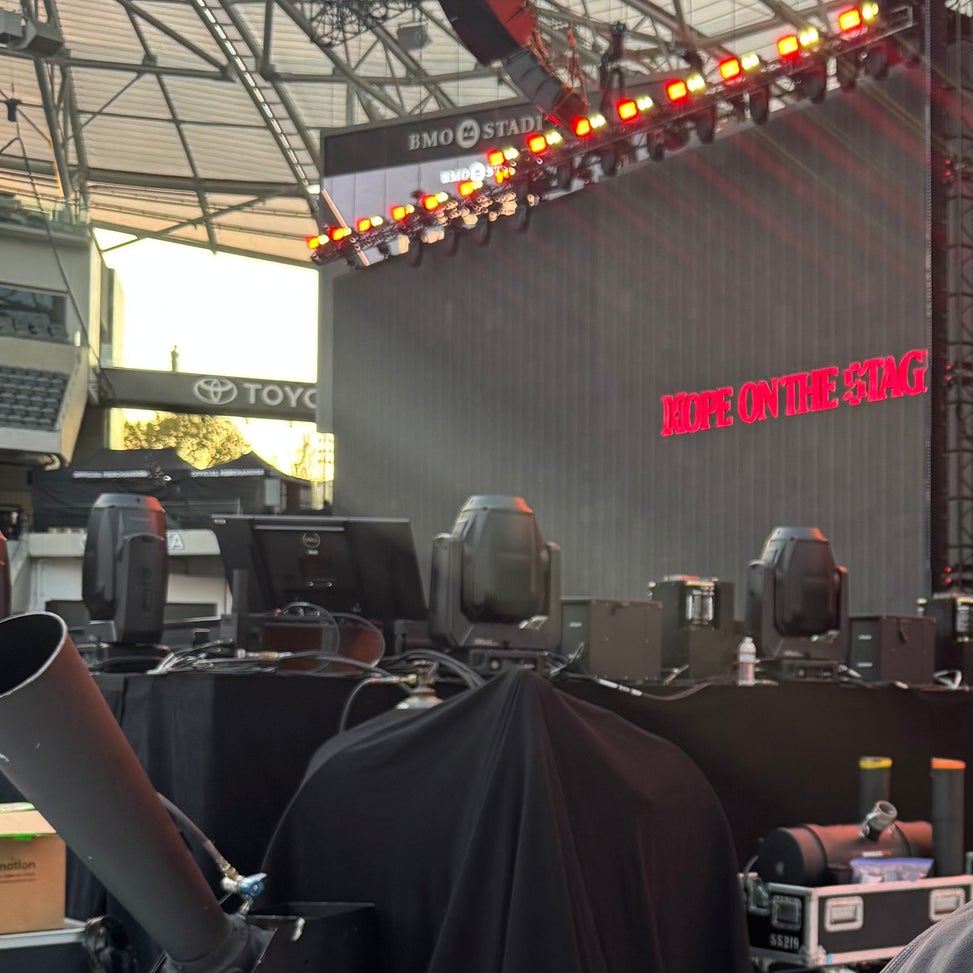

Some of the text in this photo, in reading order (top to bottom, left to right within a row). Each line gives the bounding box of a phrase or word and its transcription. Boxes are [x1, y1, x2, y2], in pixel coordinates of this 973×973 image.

[408, 128, 454, 150] BMO
[660, 348, 929, 437] HOPE ON THE STAG
